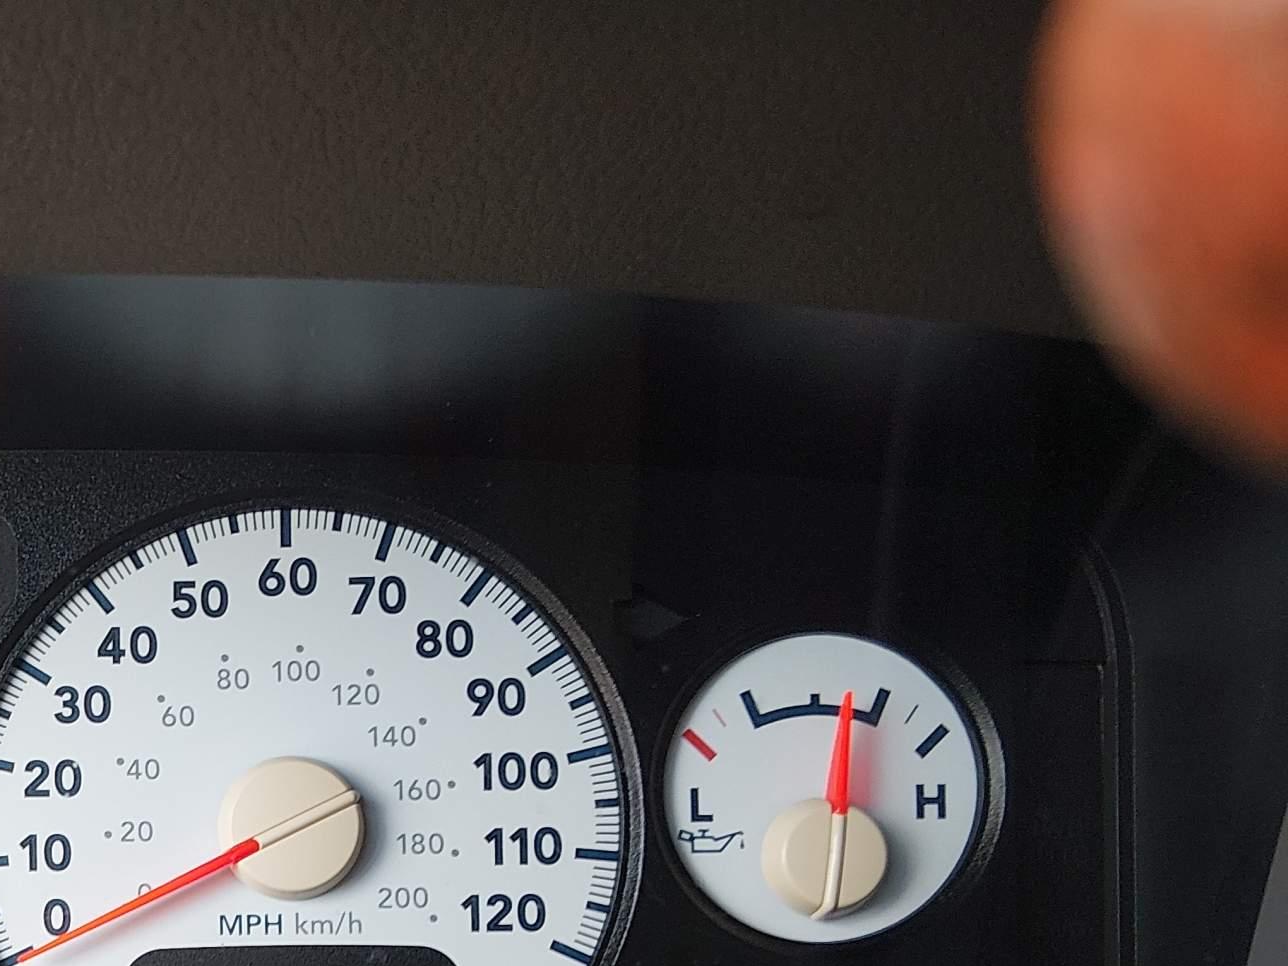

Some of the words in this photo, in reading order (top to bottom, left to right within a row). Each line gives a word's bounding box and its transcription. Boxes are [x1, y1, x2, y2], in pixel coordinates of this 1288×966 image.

[259, 557, 317, 596] 60
[171, 580, 228, 618] 50
[349, 576, 406, 615] 70
[98, 626, 157, 664] 40
[416, 620, 473, 658] 80
[217, 669, 249, 689] 80
[272, 660, 320, 682] 100
[55, 685, 111, 723] 30
[332, 684, 379, 705] 120
[467, 678, 525, 716] 90
[161, 705, 195, 728] 60
[368, 726, 415, 747] 140
[25, 760, 81, 797] 20
[127, 759, 159, 779] 40
[474, 752, 558, 790] 100
[394, 779, 440, 800] 160
[691, 788, 713, 822] L
[916, 784, 946, 819] H
[121, 821, 153, 842] 20
[397, 833, 444, 854] 180
[485, 827, 562, 865] 110
[20, 834, 71, 871] 10
[379, 888, 428, 908] 200
[461, 894, 545, 932] 120
[43, 898, 70, 935] 0
[220, 914, 282, 935] MPH
[296, 912, 362, 935] km/h
